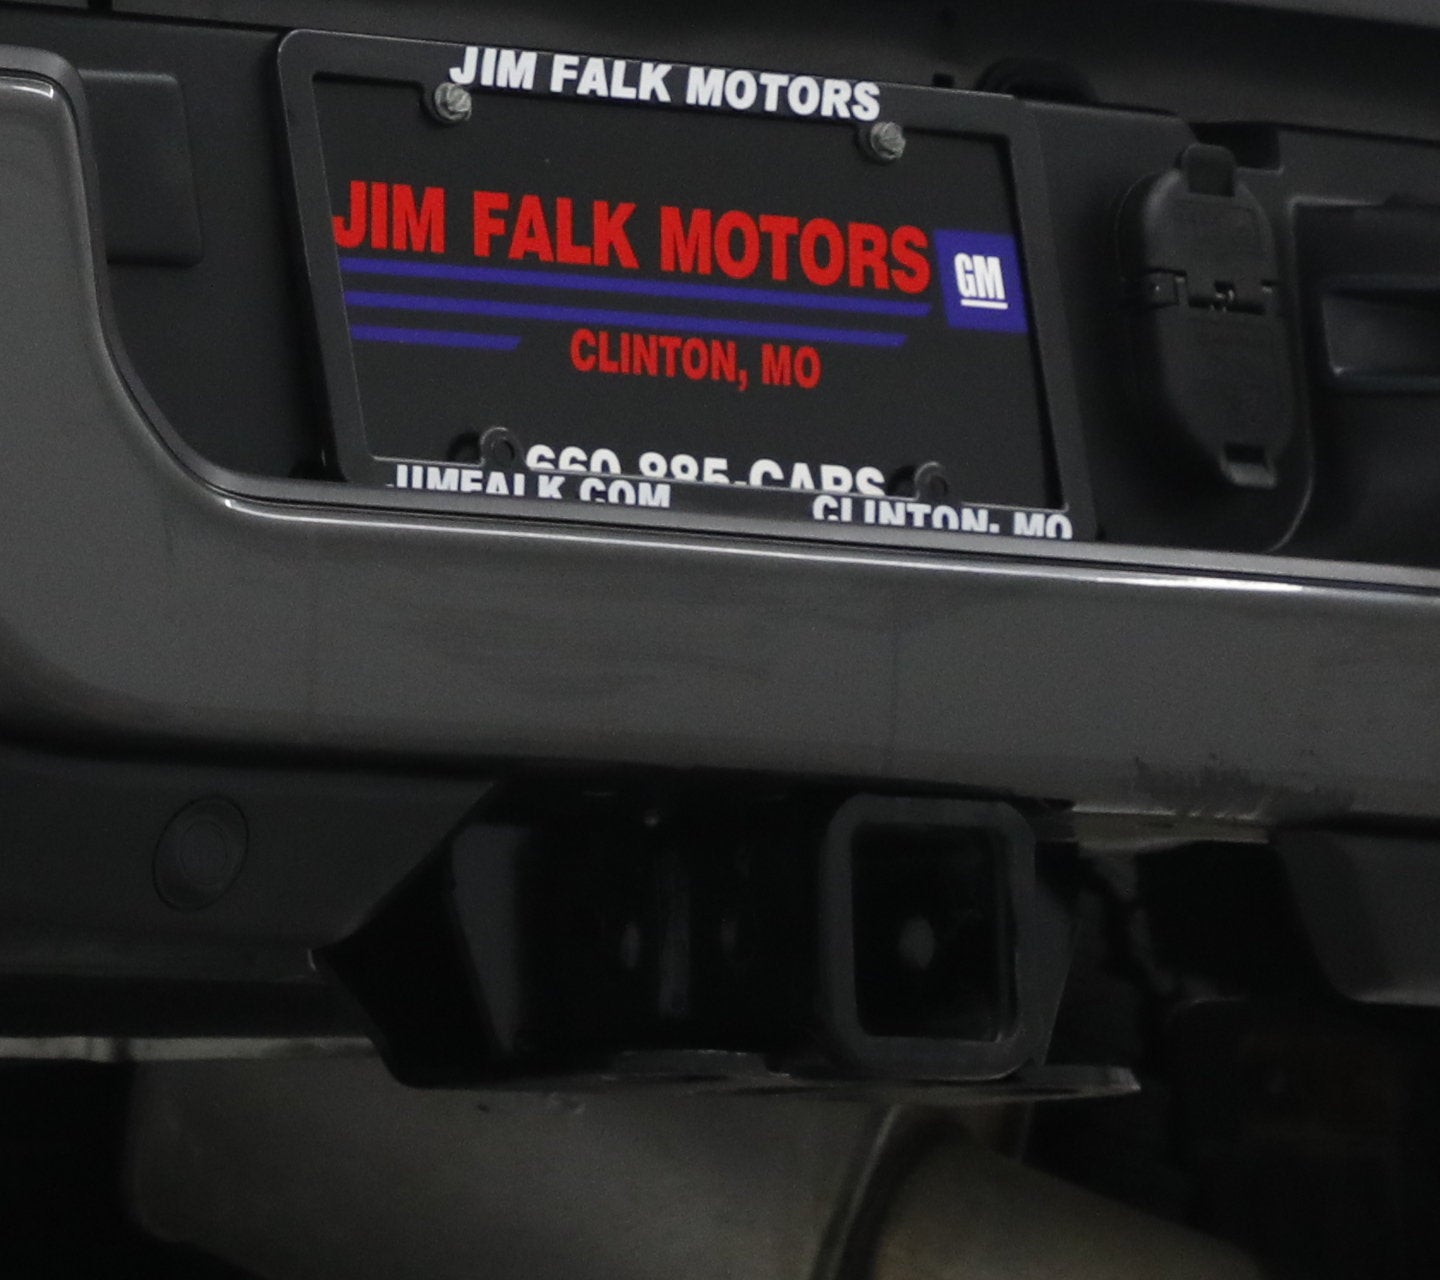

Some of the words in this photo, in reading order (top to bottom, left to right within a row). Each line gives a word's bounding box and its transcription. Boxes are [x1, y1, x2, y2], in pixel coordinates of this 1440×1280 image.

[449, 45, 538, 90] JIM
[550, 53, 673, 102] FALK
[685, 66, 880, 121] MOTORS
[332, 179, 447, 254] JIM
[472, 190, 640, 269] FALK
[659, 205, 932, 295] MOTORS
[954, 252, 1009, 300] GM
[569, 328, 749, 391] CLINTON,
[762, 342, 822, 389] MO
[1012, 511, 1074, 540] MO
